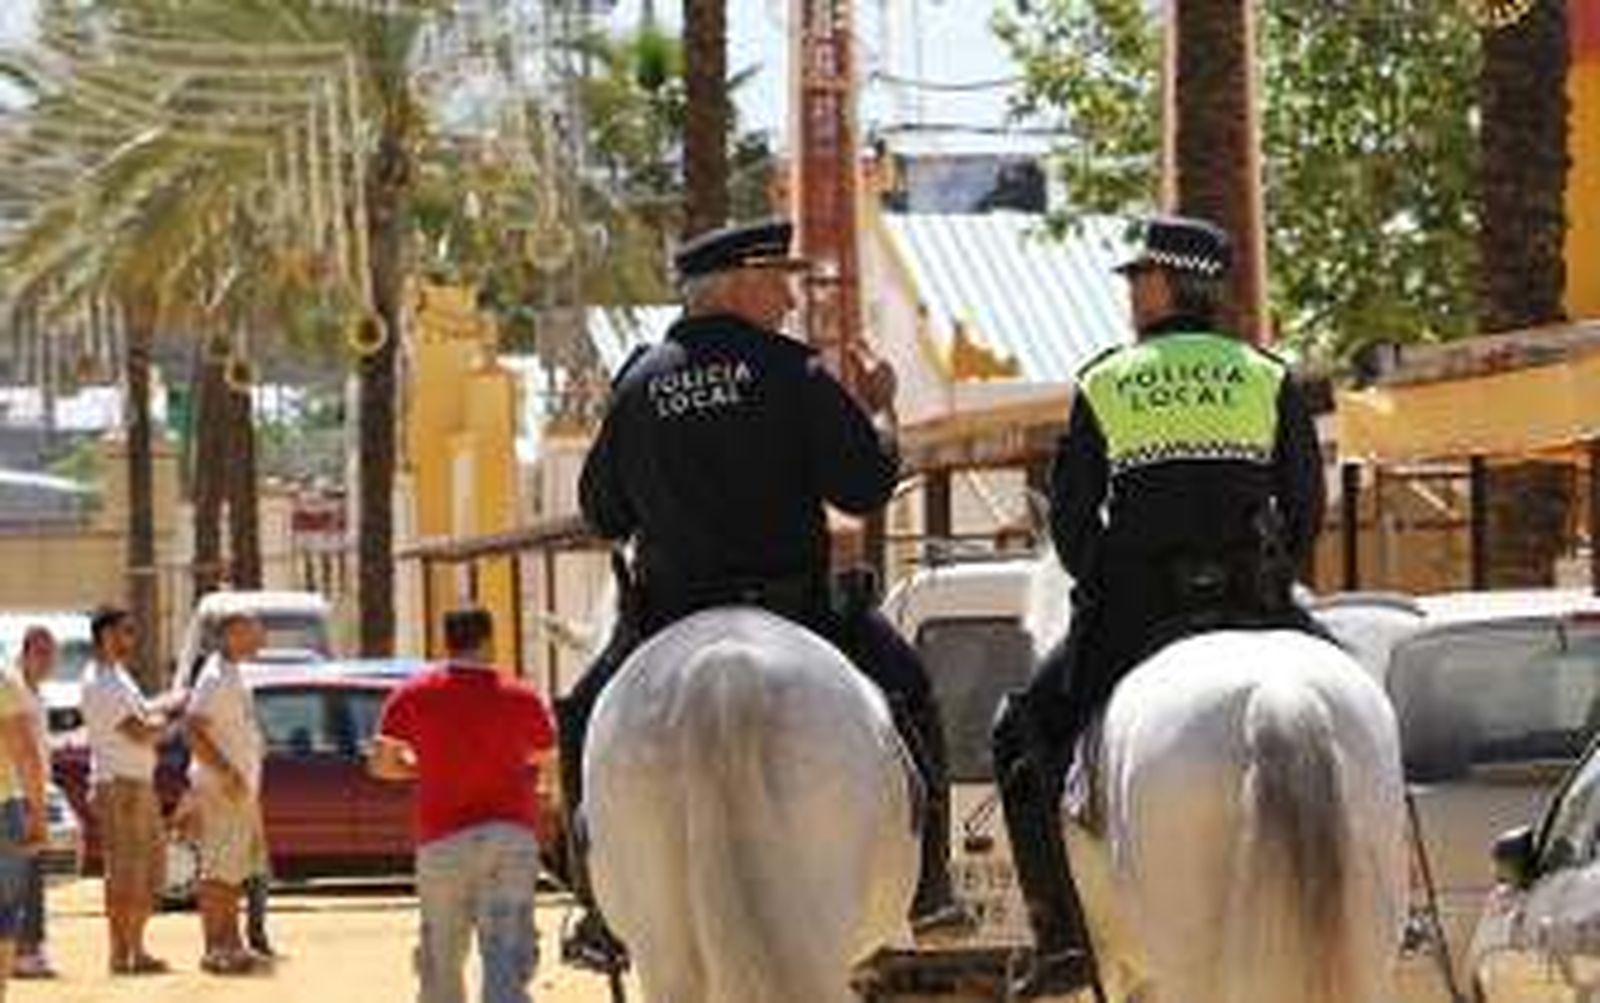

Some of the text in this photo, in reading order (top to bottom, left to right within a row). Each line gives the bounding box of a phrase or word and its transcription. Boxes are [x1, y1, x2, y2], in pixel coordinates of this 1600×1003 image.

[647, 361, 752, 401] POLICIA
[1116, 364, 1246, 397] POLICIA
[657, 380, 740, 418] LOCAL
[1130, 385, 1234, 412] LOCAL
